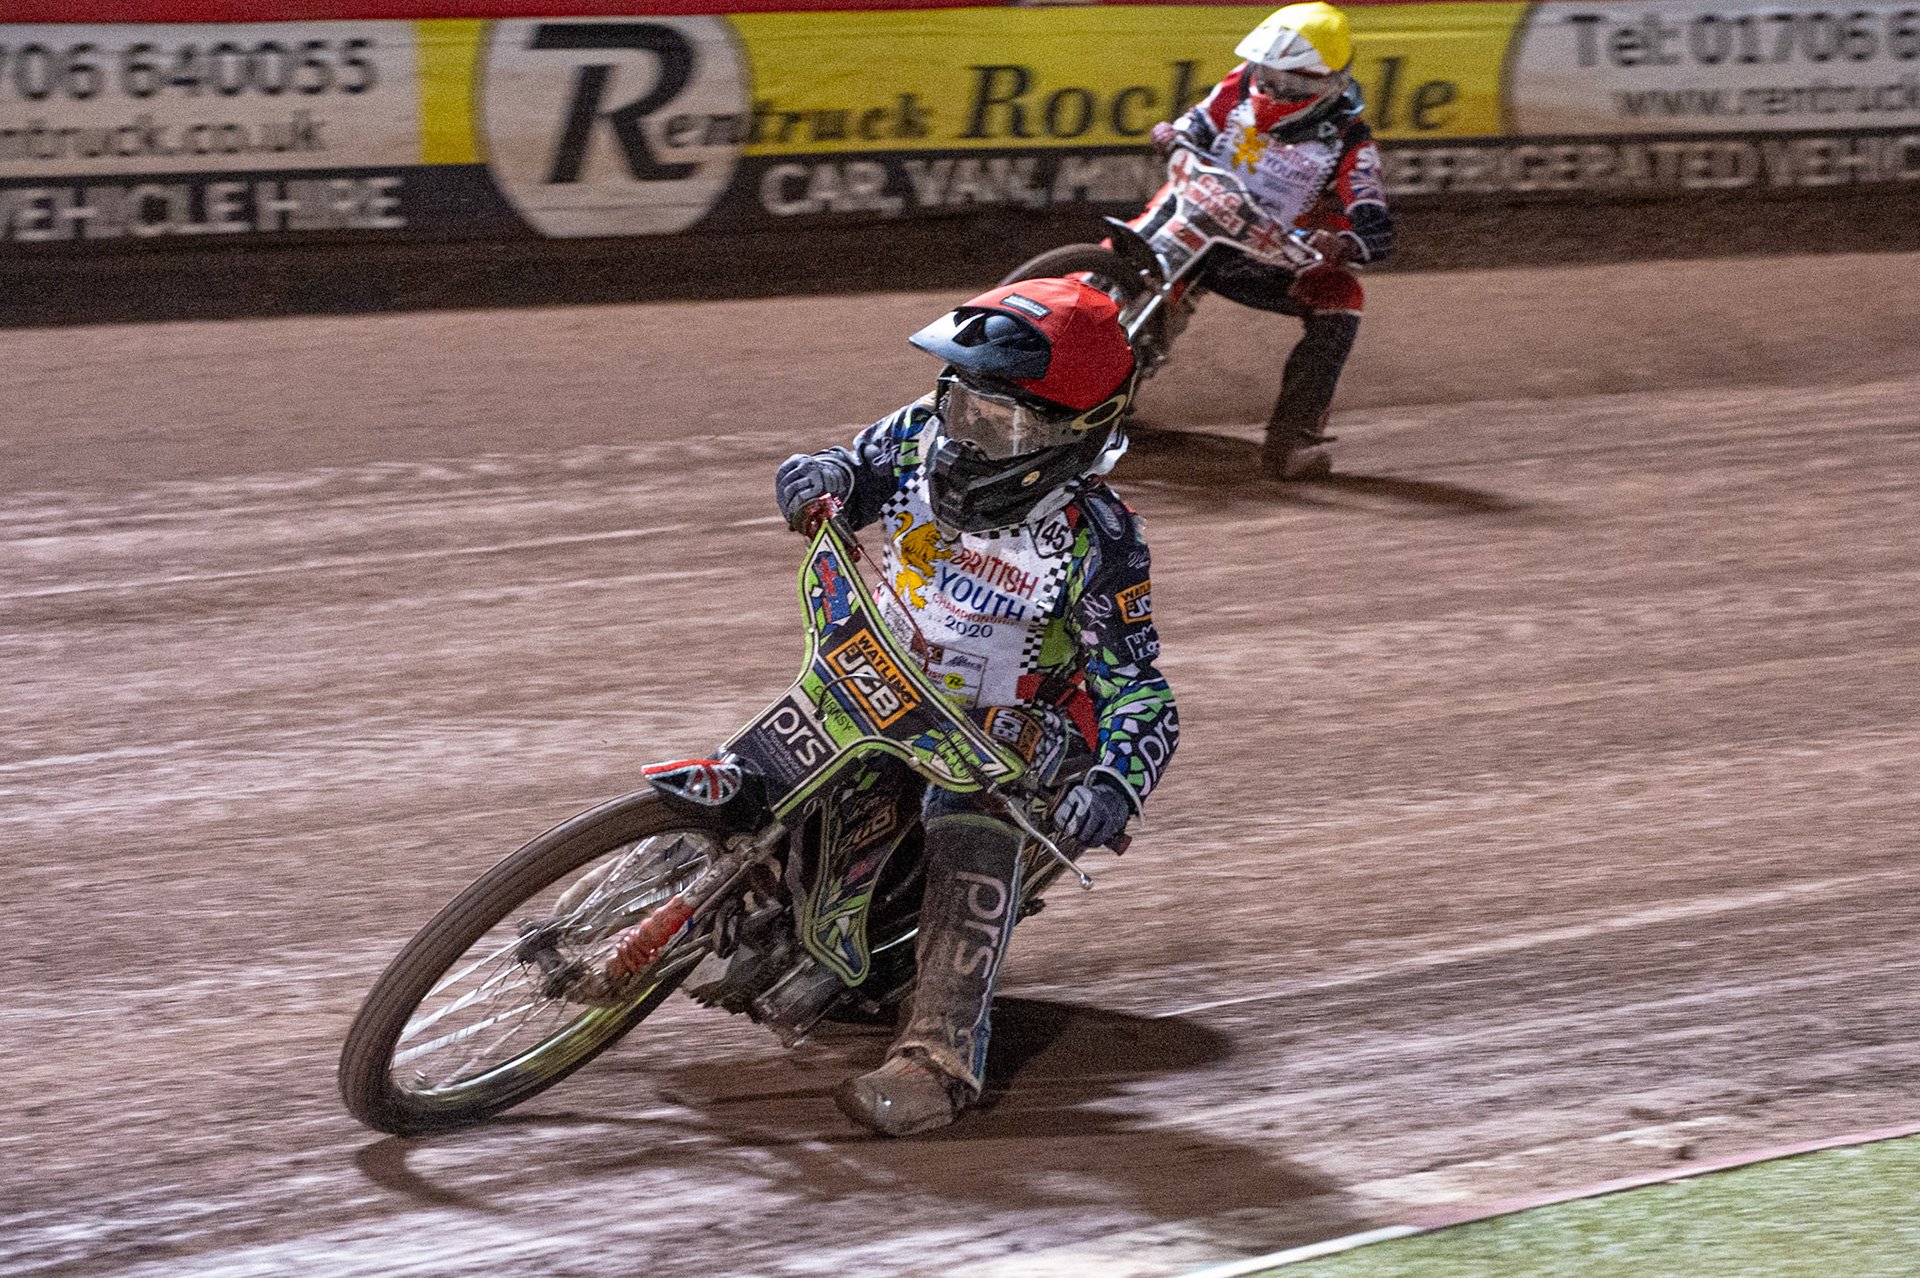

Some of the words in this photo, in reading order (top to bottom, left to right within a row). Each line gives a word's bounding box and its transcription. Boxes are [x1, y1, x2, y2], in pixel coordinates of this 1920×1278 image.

[1692, 11, 1879, 66] 01706
[0, 41, 101, 99] 06
[121, 38, 376, 98] 640055
[528, 22, 934, 185] Rentruck
[958, 56, 1460, 141] Rochle
[1382, 141, 1759, 196] EFRIGERATED
[257, 175, 406, 233] HIRE
[940, 566, 1026, 621] YOUTH
[950, 548, 1040, 600] BRITISH
[944, 615, 993, 638] 2020
[837, 648, 900, 718] JCB
[761, 706, 827, 767] prs
[955, 870, 1007, 979] prs
